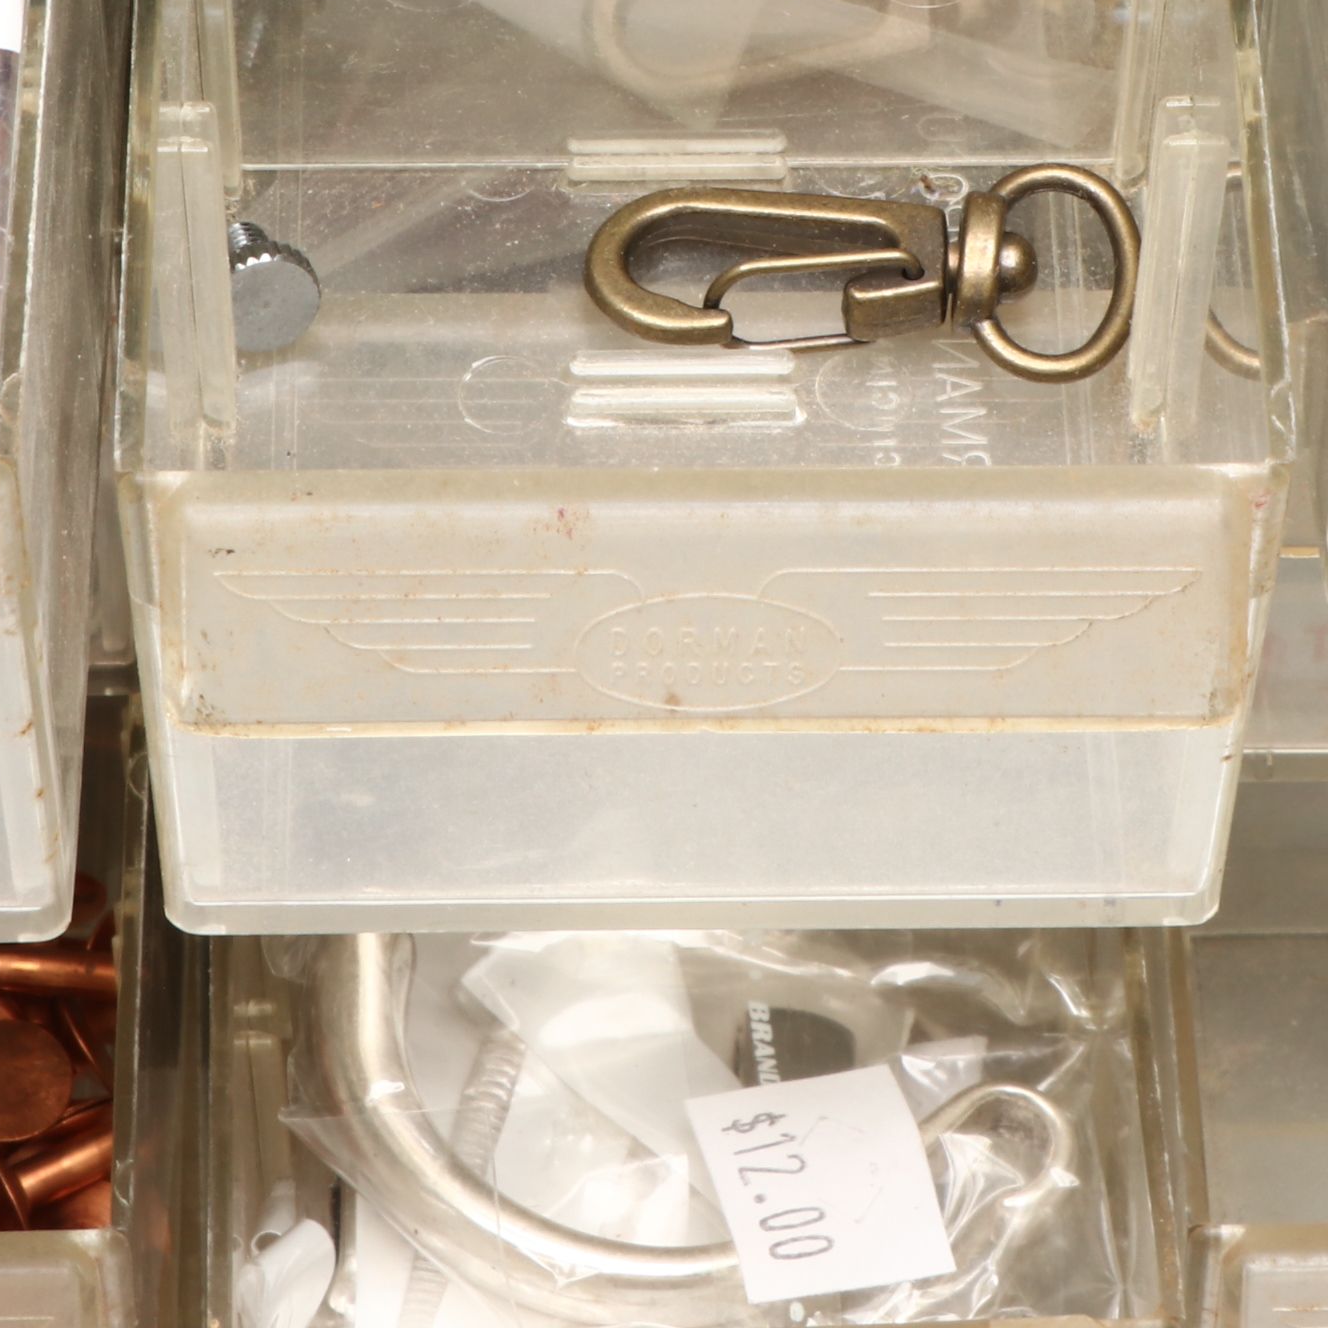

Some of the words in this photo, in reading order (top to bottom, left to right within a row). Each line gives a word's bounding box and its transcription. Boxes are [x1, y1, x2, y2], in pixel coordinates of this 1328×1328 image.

[609, 625, 805, 657] DORMAN
[610, 660, 805, 686] PRODUCTS
[721, 1111, 835, 1260] $12.00
